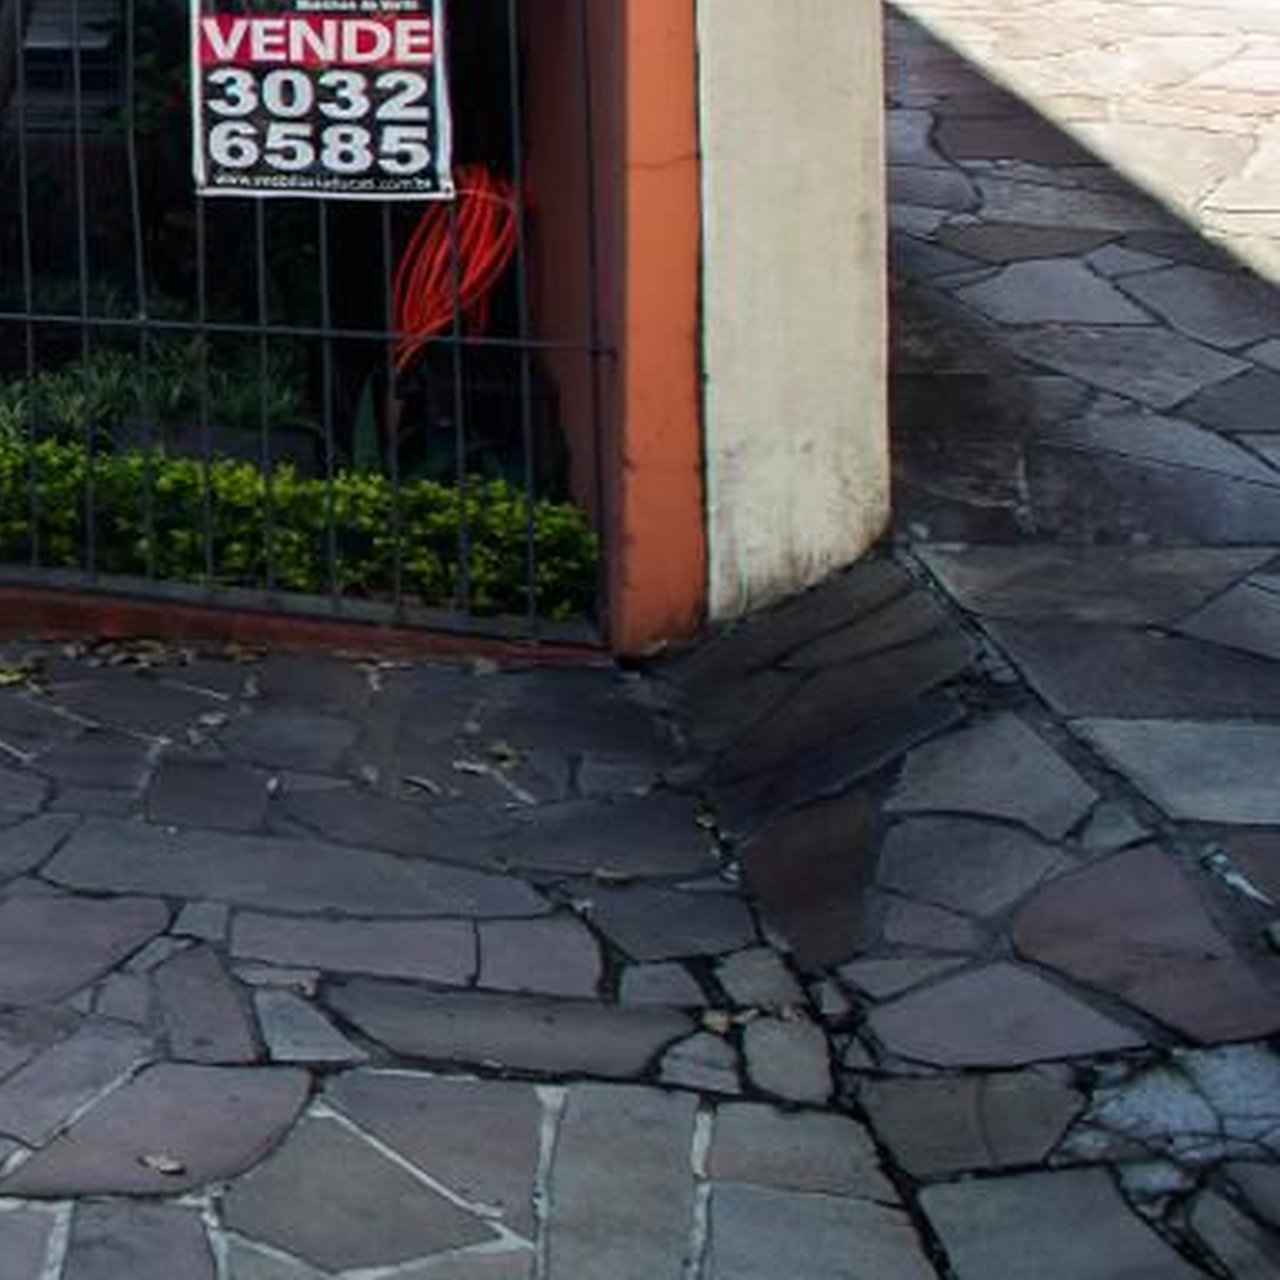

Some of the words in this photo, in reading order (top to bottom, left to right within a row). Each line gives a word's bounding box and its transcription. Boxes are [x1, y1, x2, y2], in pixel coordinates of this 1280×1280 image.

[202, 19, 433, 62] VENDE
[206, 68, 430, 120] 3032
[208, 120, 431, 174] 6585
